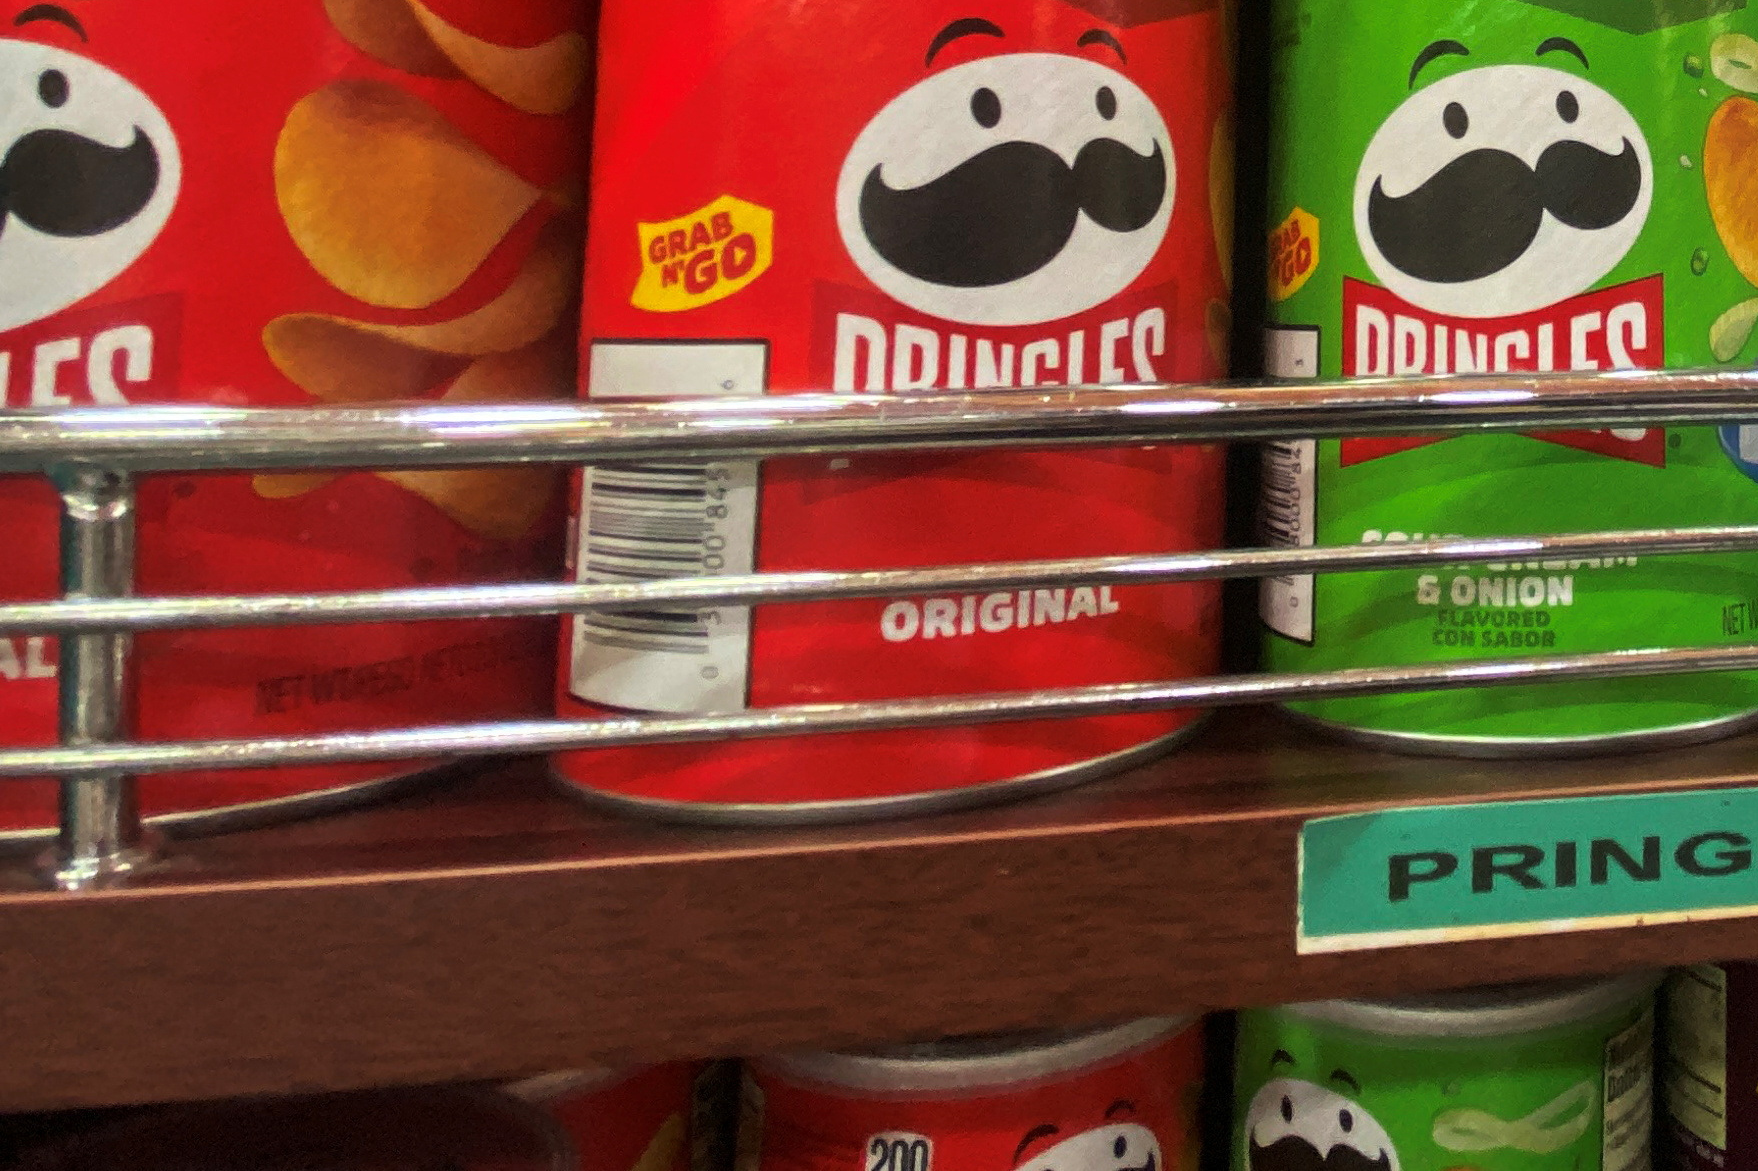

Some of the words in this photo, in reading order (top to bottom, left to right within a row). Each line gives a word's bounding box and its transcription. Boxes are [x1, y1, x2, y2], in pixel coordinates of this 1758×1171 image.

[648, 211, 733, 265] GRAB
[683, 232, 758, 297] GO
[1417, 575, 1440, 605] &
[1451, 575, 1574, 607] ONION
[880, 586, 1119, 642] ORIGINAL
[1438, 610, 1551, 627] FLAVORED
[1432, 630, 1476, 647] CON
[1481, 630, 1556, 648] SABOR
